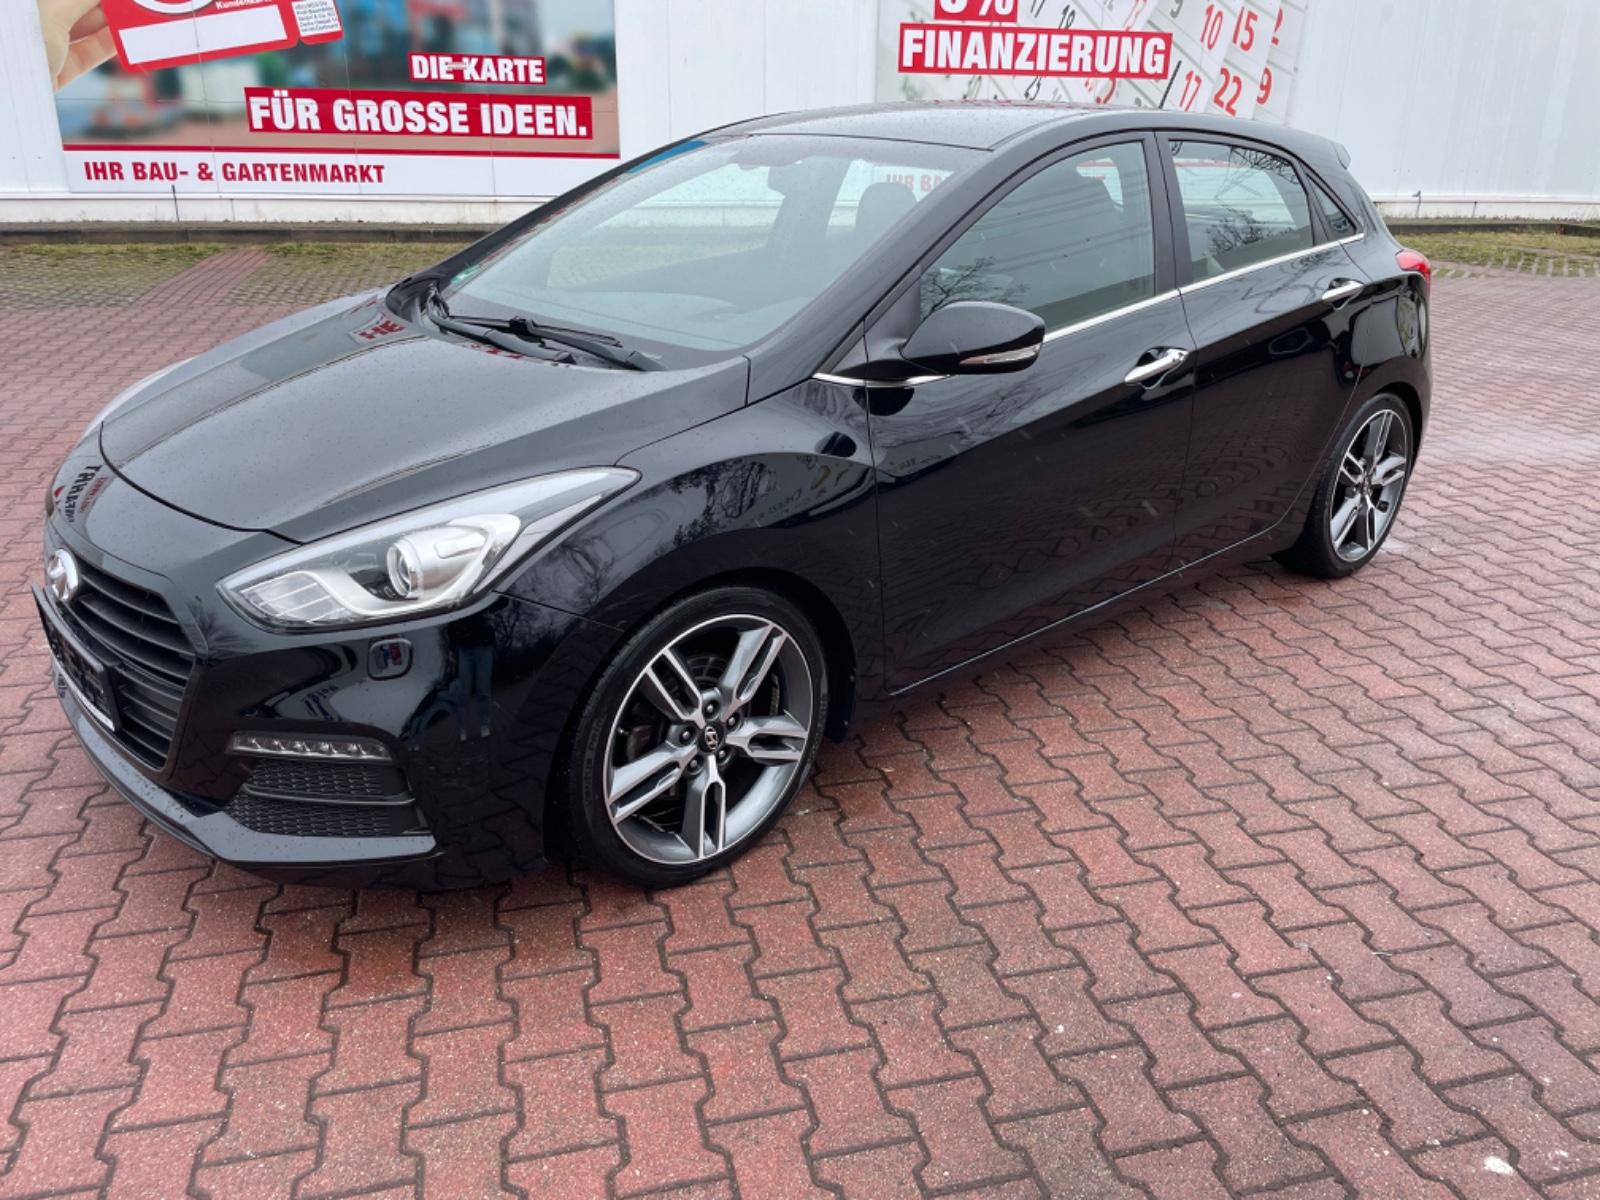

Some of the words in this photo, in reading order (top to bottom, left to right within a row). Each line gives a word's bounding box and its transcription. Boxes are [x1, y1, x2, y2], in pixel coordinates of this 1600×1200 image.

[1200, 4, 1223, 50] 10
[1232, 6, 1258, 51] 15
[411, 54, 454, 80] DIE
[462, 57, 544, 82] KARTE
[903, 29, 1166, 74] FINANZIERUNG
[248, 90, 319, 131] FÜR
[333, 98, 468, 134] GROSSE
[481, 102, 587, 137] IDEEN.
[1179, 70, 1202, 112] 17
[1213, 67, 1242, 115] 22
[84, 160, 124, 181] IHR
[132, 161, 189, 182] BAU-
[197, 163, 214, 182] &
[221, 163, 385, 184] GARTENMARKT
